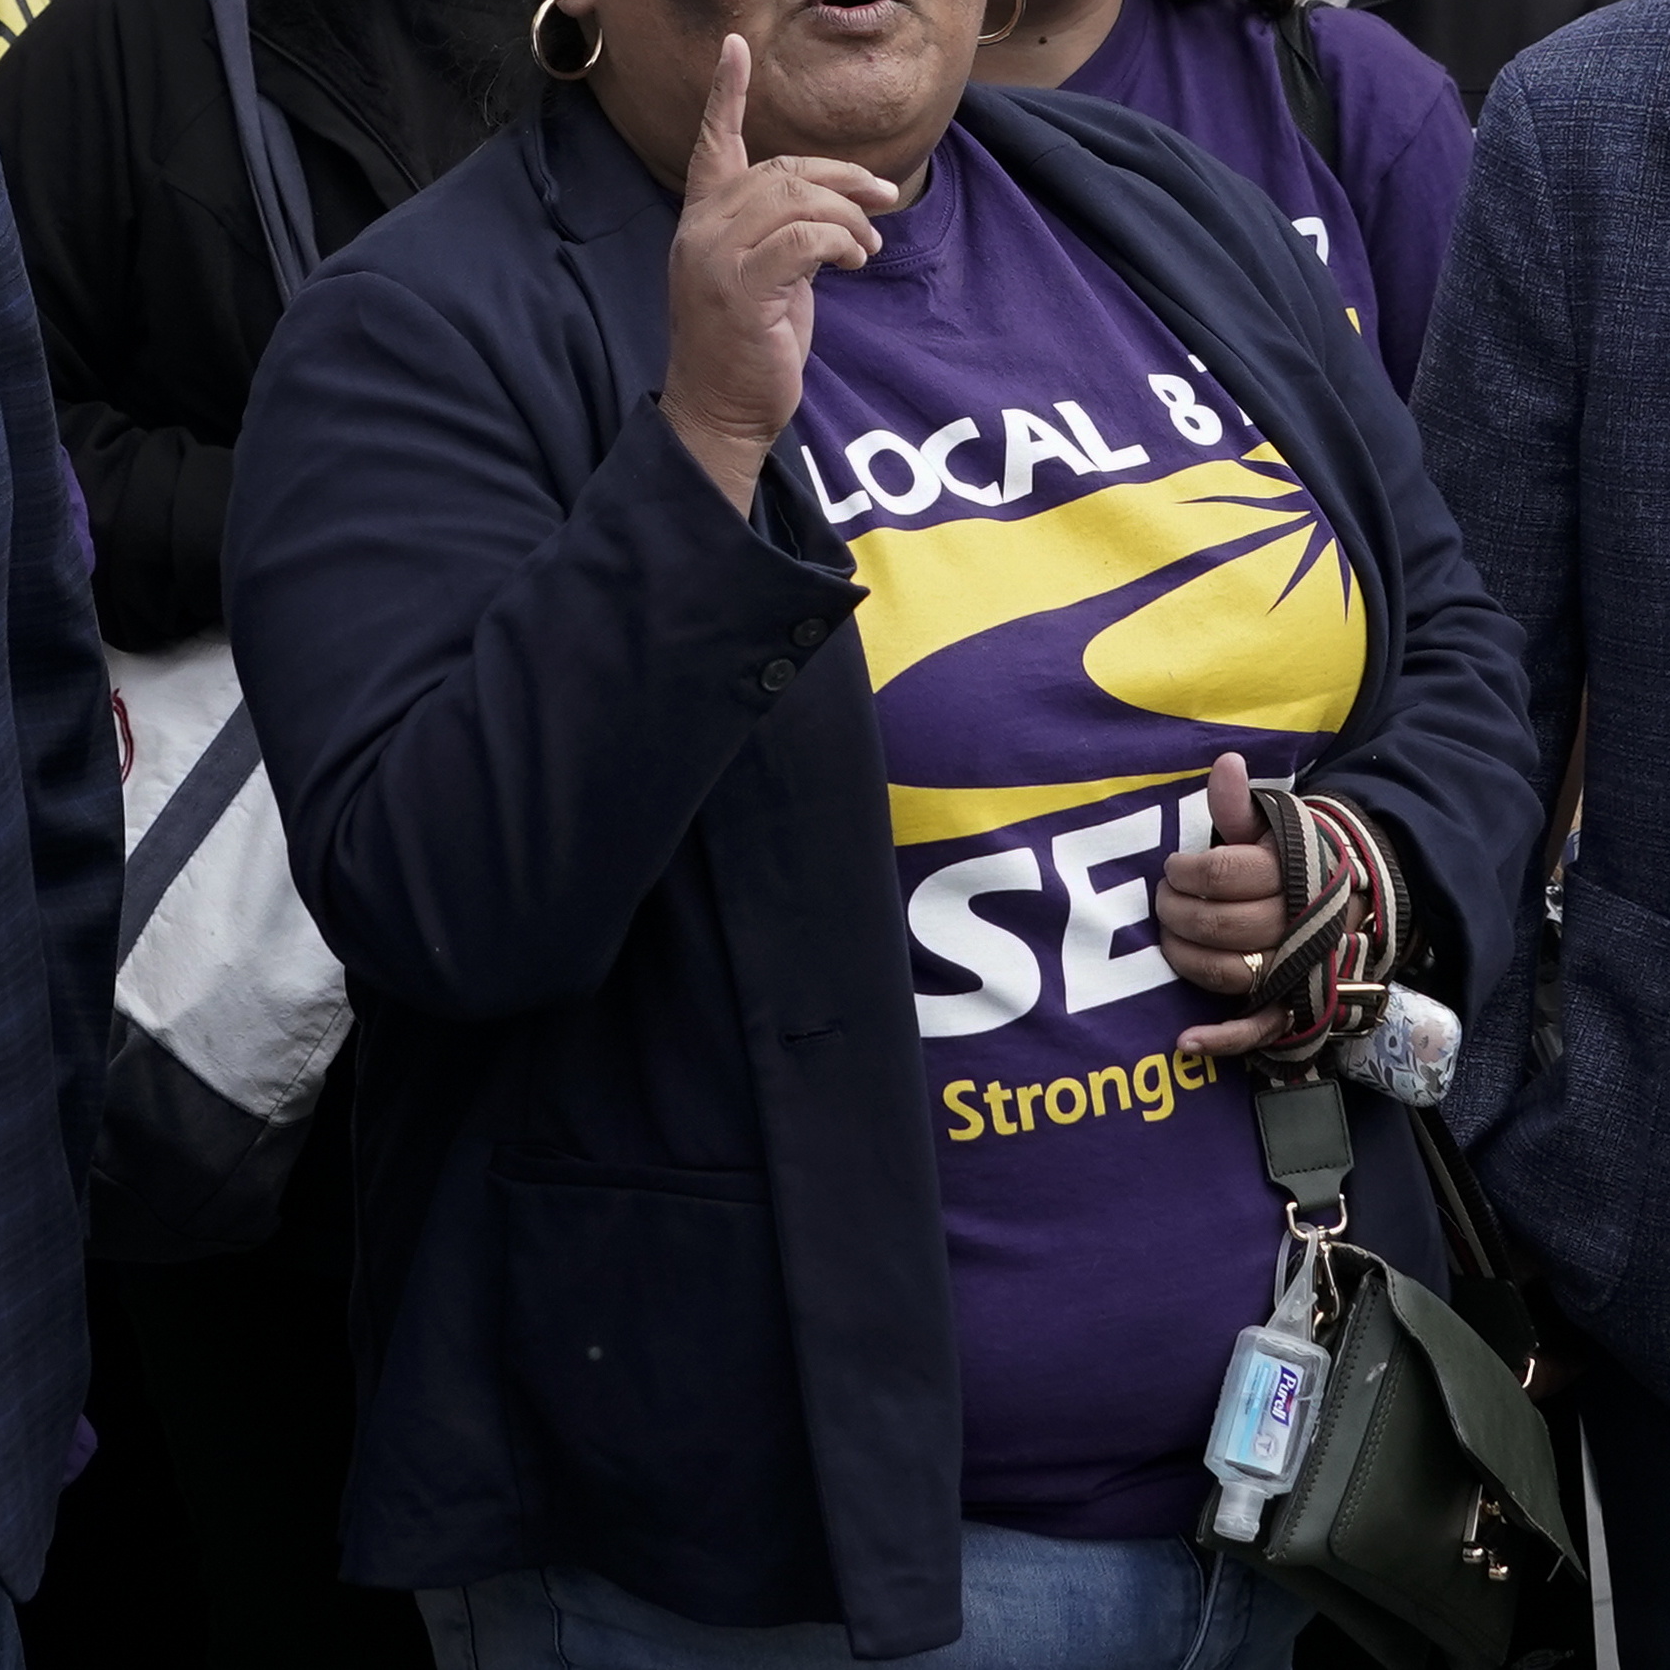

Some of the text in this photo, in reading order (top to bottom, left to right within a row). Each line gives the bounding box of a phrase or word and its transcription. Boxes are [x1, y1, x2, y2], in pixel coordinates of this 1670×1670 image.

[802, 353, 1255, 526] LOCAL 8
[942, 1048, 1219, 1142] Stronger
[1271, 1372, 1298, 1424] Purell
